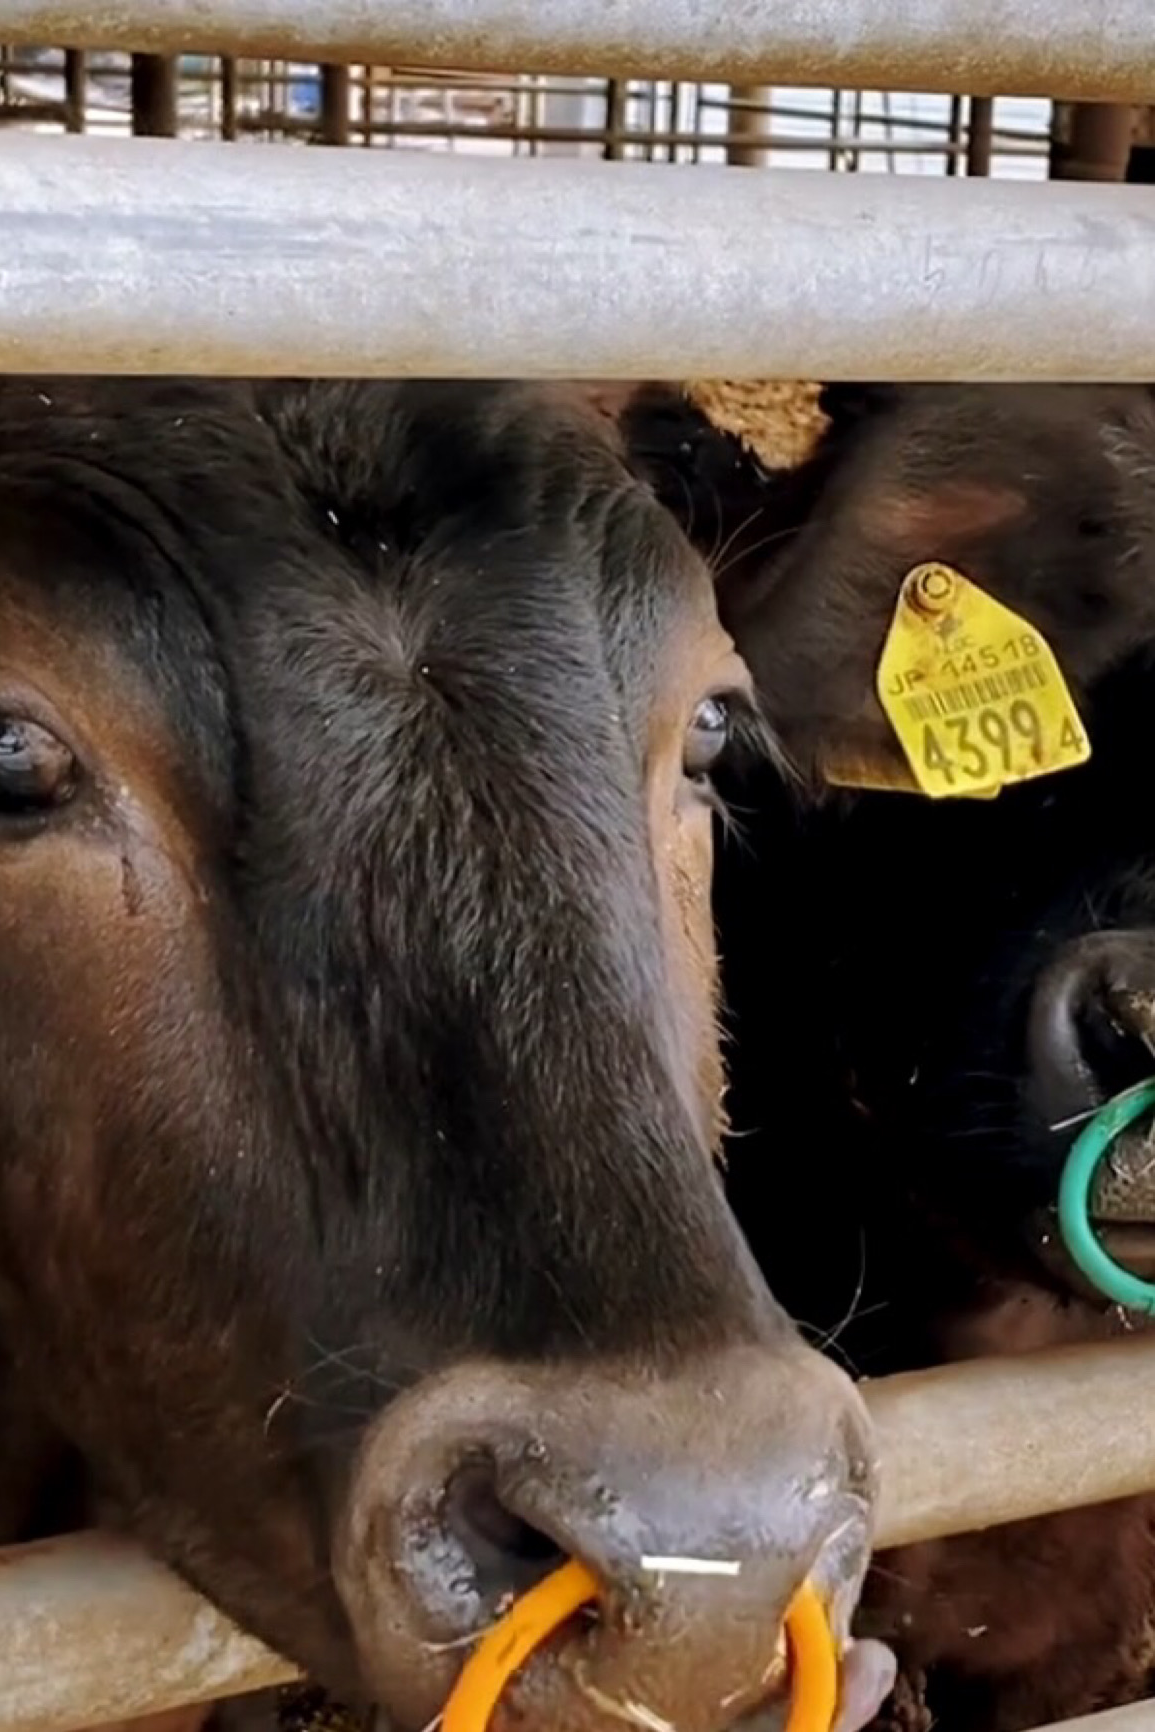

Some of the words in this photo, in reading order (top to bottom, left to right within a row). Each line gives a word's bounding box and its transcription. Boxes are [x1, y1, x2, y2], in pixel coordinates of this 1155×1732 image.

[887, 669, 926, 696] JP
[940, 634, 1039, 679] 14518
[922, 698, 1042, 786] 4399
[1059, 715, 1084, 754] 4
